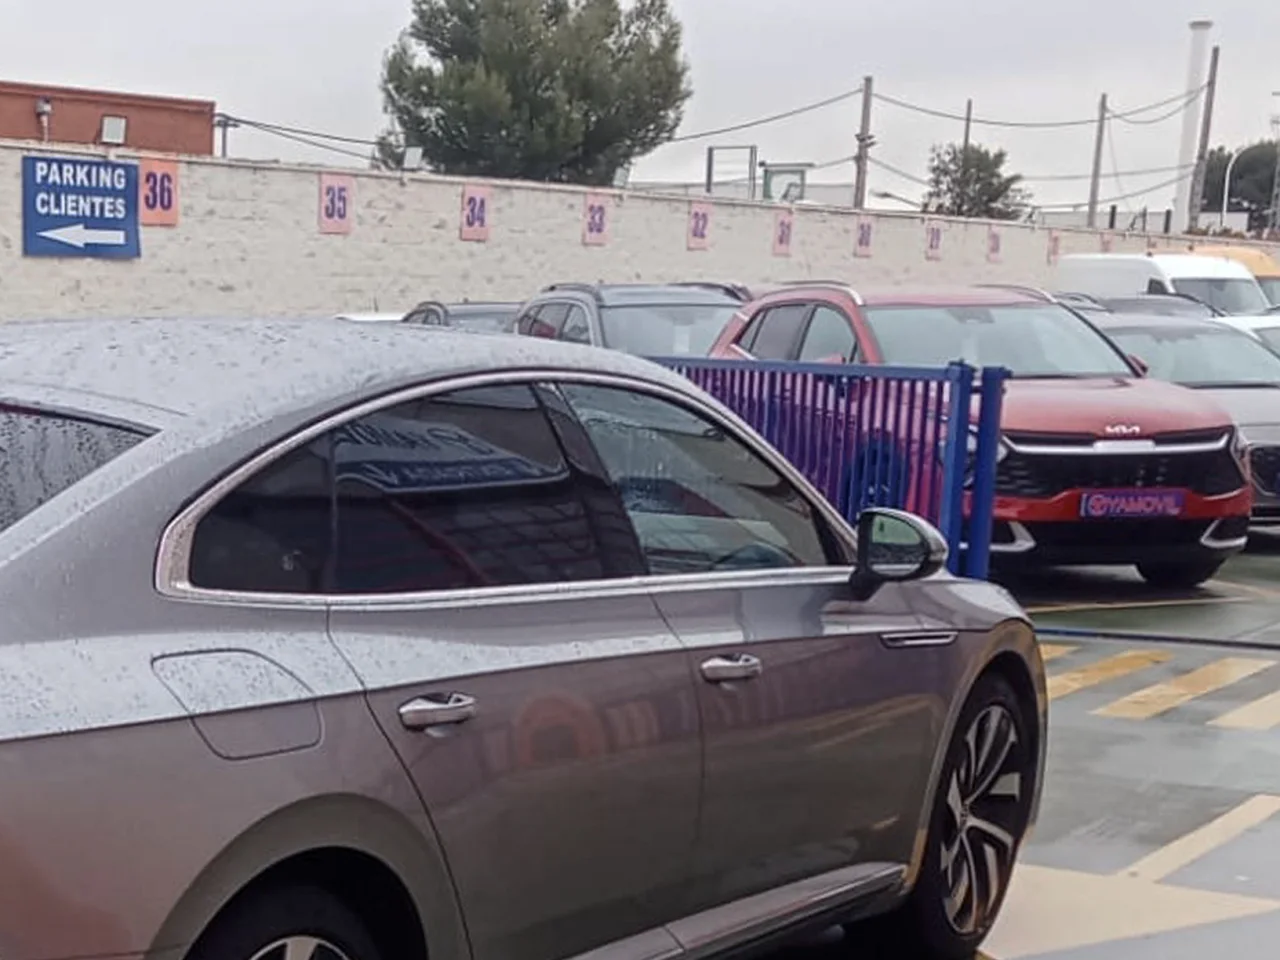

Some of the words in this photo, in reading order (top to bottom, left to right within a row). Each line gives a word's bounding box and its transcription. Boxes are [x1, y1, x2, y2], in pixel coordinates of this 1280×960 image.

[34, 161, 127, 189] PARKING
[144, 170, 174, 211] 36
[35, 191, 127, 219] CLIENTES
[324, 184, 348, 221] 35
[466, 195, 486, 228] 34
